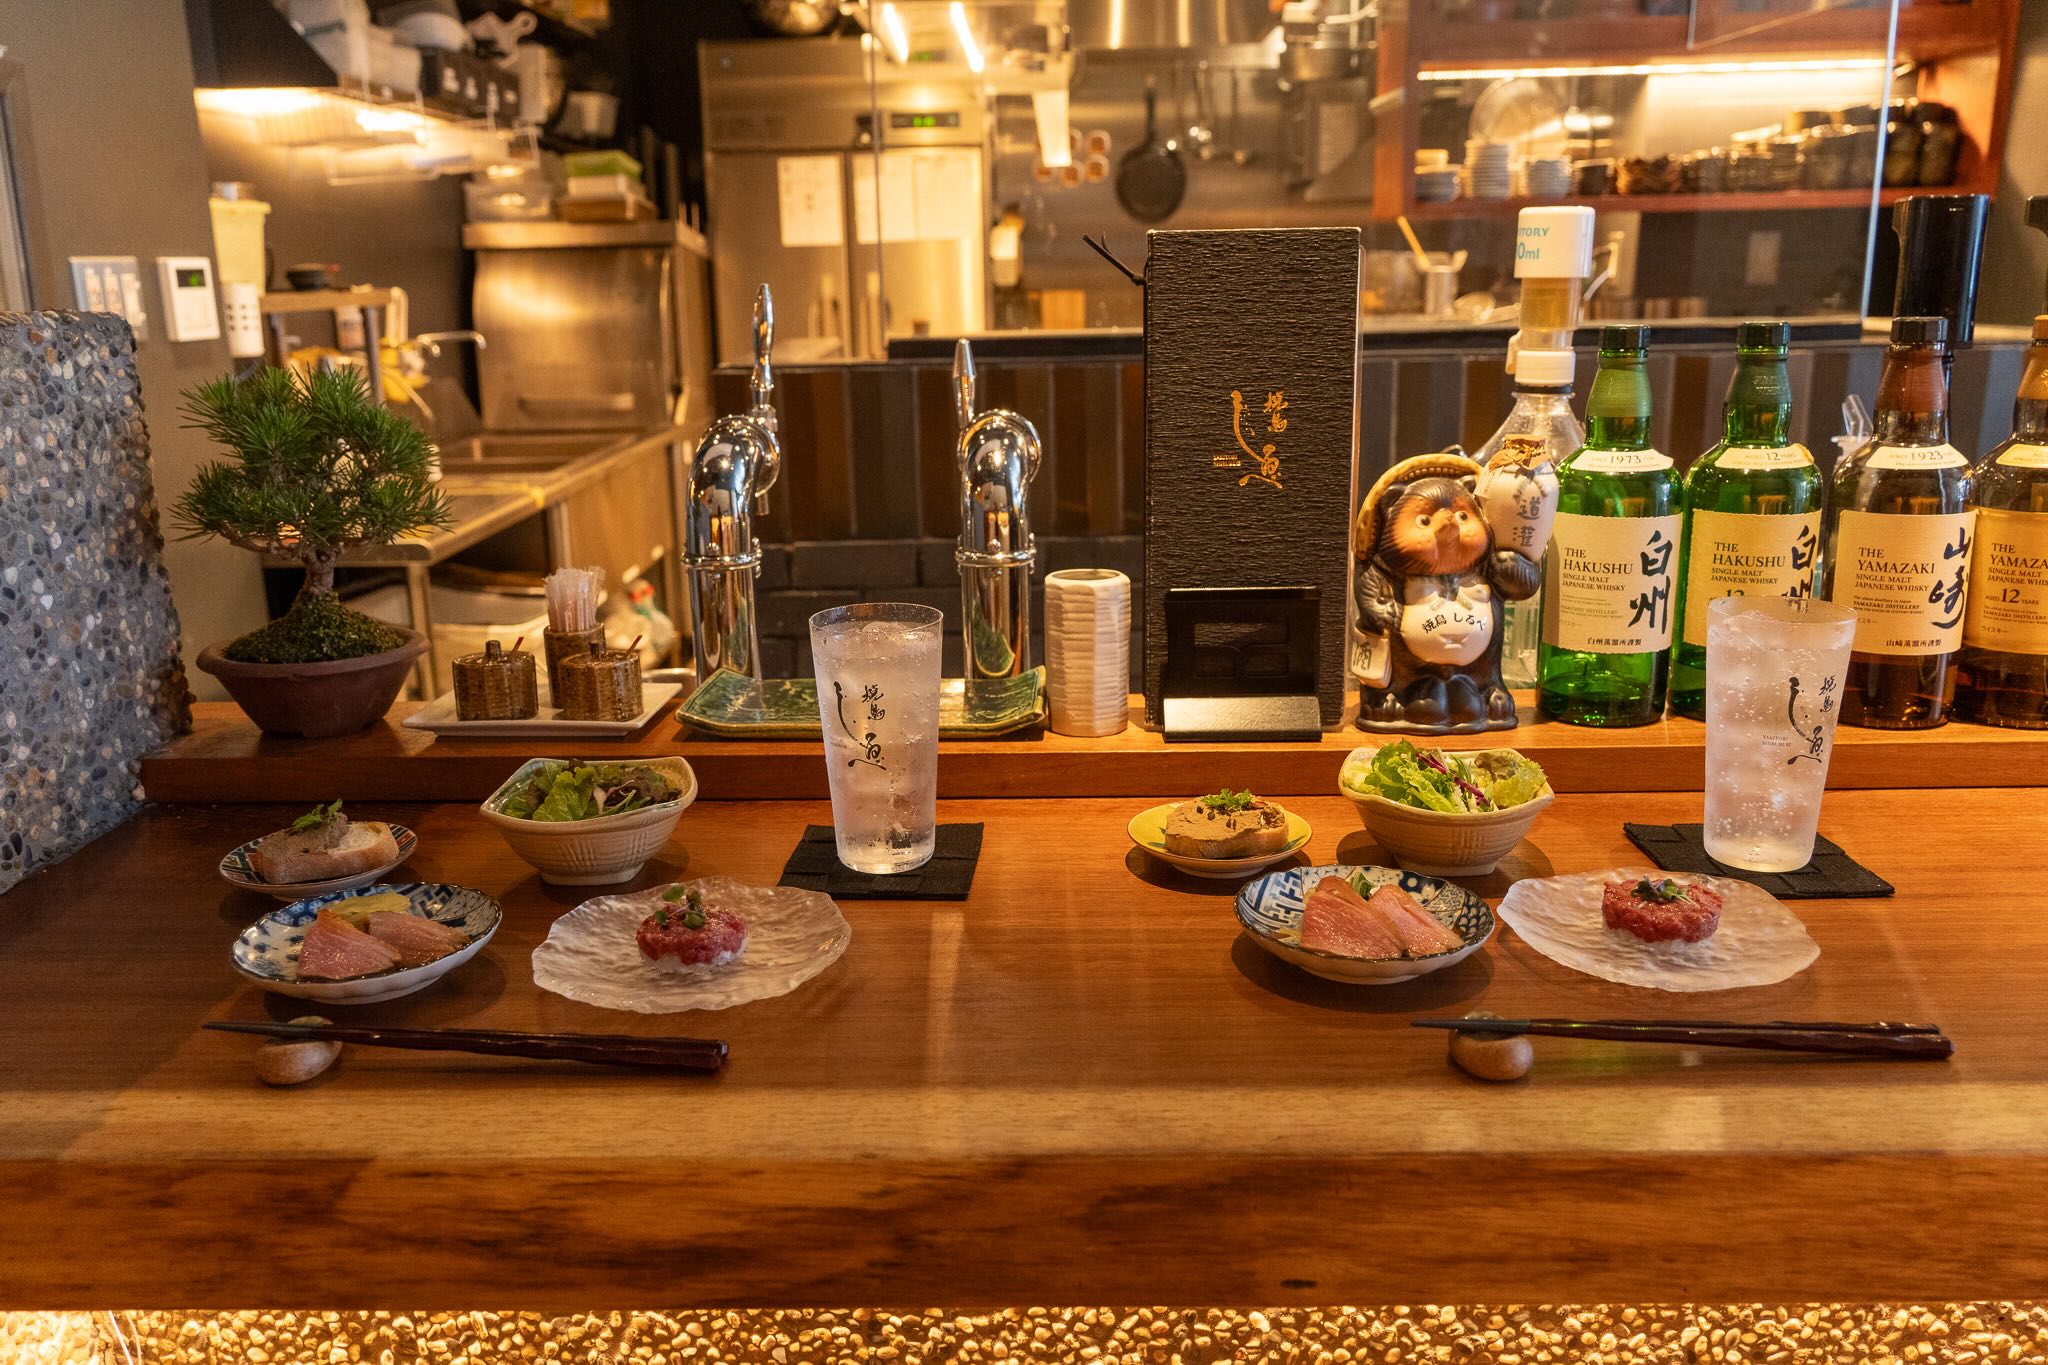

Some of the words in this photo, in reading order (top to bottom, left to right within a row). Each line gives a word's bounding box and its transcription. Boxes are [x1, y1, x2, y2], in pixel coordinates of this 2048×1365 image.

[1609, 455, 1642, 464] 1973
[1766, 452, 1781, 461] 12
[1911, 451, 1944, 461] 1923
[1564, 547, 1587, 558] THE
[1714, 541, 1739, 553] THE
[1858, 546, 1885, 559] THE
[1991, 542, 2016, 554] THE
[1712, 553, 1786, 568] HAKUSHU
[1563, 559, 1633, 575] HAKUSHU
[1711, 567, 1739, 576] SINGLE
[1741, 569, 1763, 577] MALT
[1857, 559, 1935, 575] YAMAZAKI
[1988, 567, 2017, 576] SINGLE
[2018, 570, 2043, 578] MALT
[1562, 573, 1587, 582] SINGLE
[1628, 529, 1673, 634] 白州
[1711, 575, 1748, 584] JAPANESE
[1749, 577, 1779, 585] WHISKY
[1855, 573, 1886, 582] SINGLE
[1987, 574, 2026, 585] JAPANESE
[1562, 580, 1595, 590] JAPANESE
[1855, 581, 1895, 591] JAPANESE
[2001, 587, 2021, 604] 12
[1421, 614, 1447, 634] 焼鳥
[1352, 641, 1373, 671] 酒
